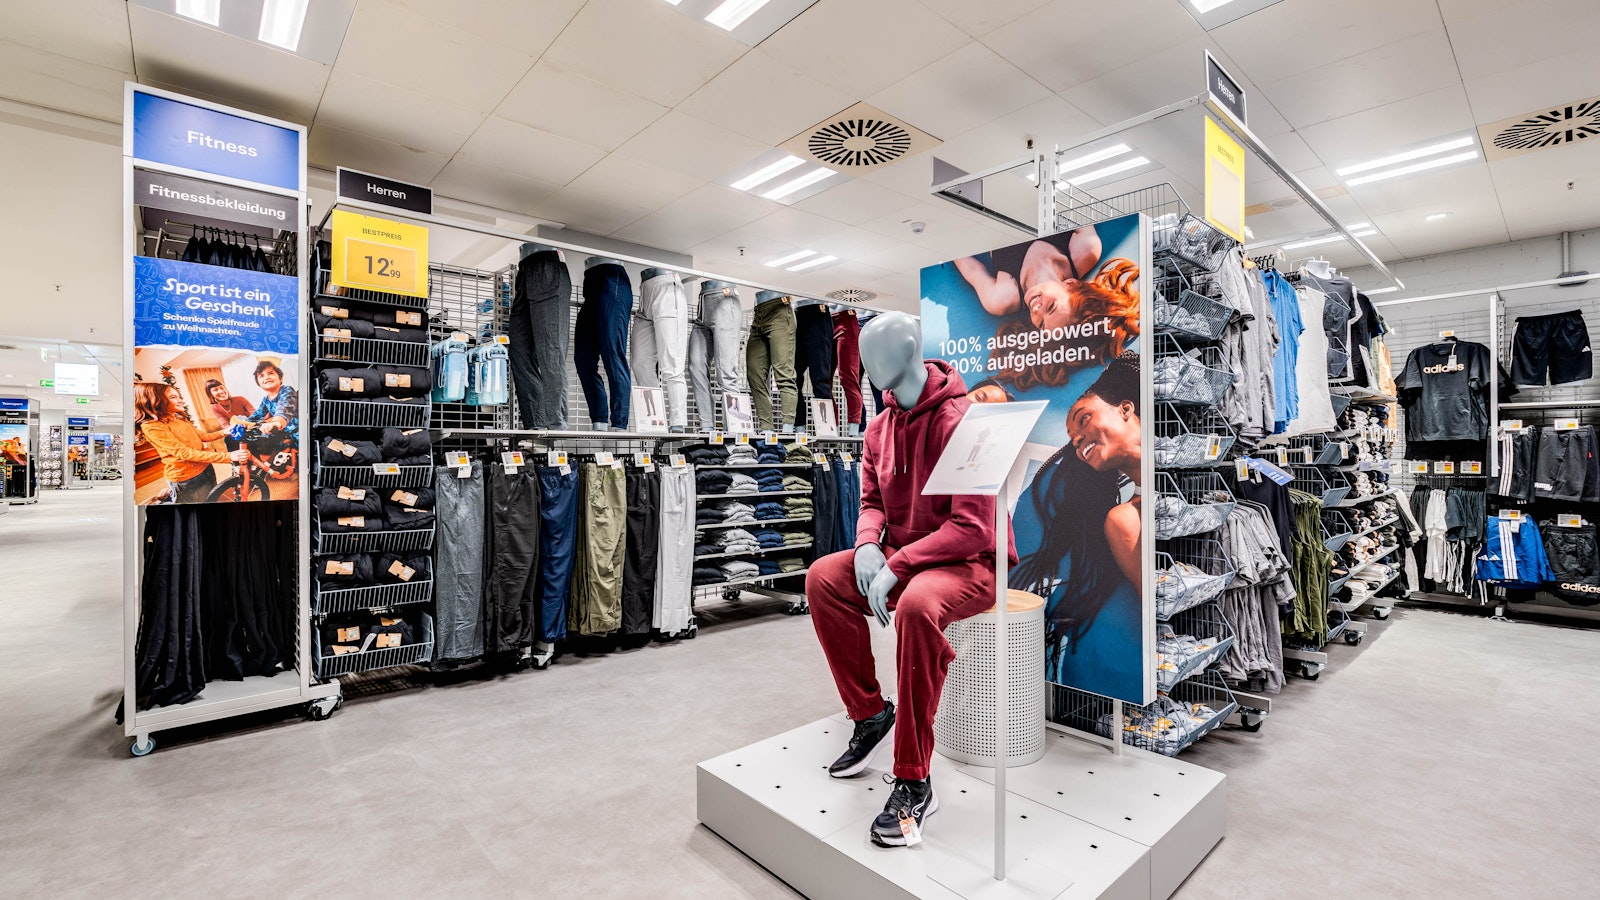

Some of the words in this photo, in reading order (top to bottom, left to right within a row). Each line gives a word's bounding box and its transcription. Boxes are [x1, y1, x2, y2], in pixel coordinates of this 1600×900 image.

[1217, 77, 1236, 104] Herren
[187, 129, 258, 157] Fitness
[149, 183, 286, 220] Fitnessbekleidung
[367, 182, 407, 200] Herren
[362, 227, 402, 240] BESTPREIS
[364, 255, 390, 277] 12
[162, 278, 217, 296] Sport
[219, 284, 242, 299] ist
[244, 288, 271, 302] ein
[185, 296, 275, 318] Geschenk
[163, 312, 206, 324] Schenke
[206, 316, 260, 328] Spielfreude
[176, 323, 242, 336] Weihnachten.
[939, 336, 982, 356] 100%
[986, 317, 1117, 349] ausgepowert,
[949, 356, 983, 374] 00%
[987, 346, 1096, 372] aufgeladen.
[1423, 363, 1465, 374] adids
